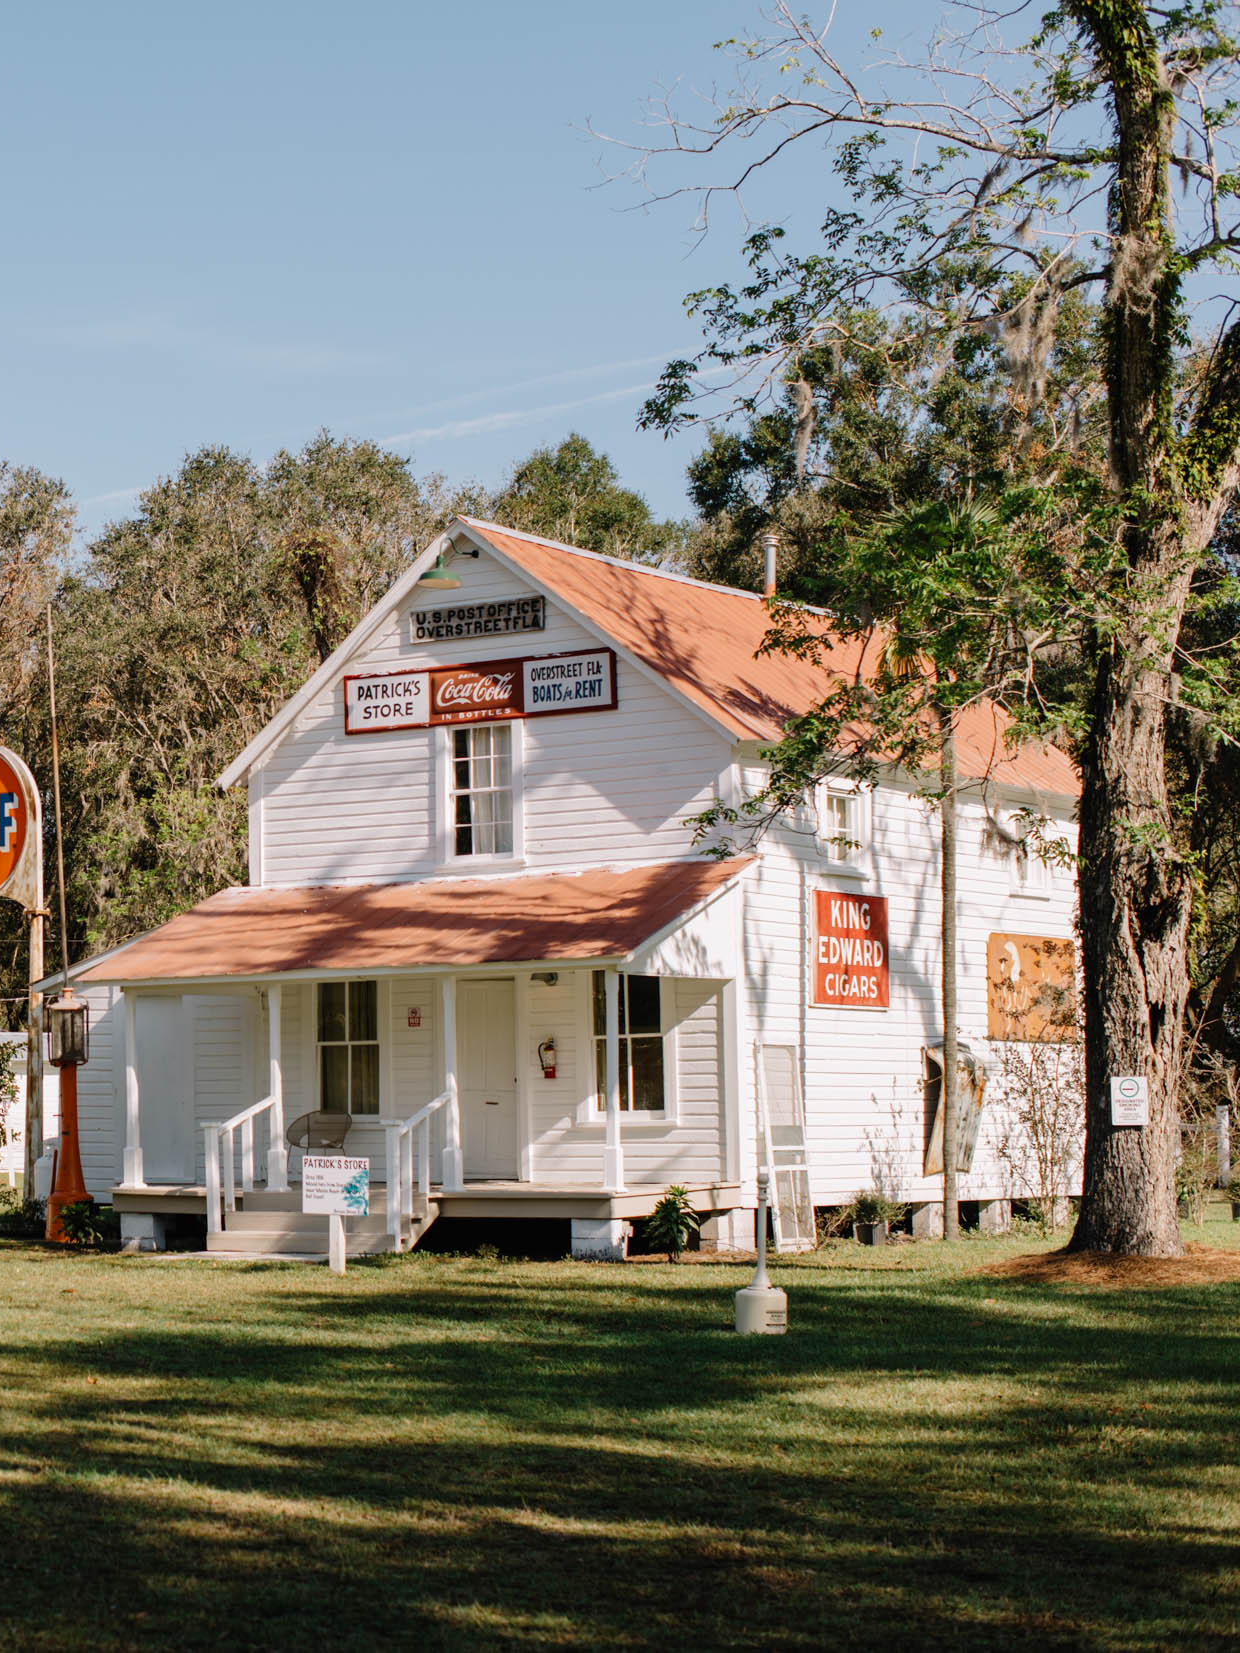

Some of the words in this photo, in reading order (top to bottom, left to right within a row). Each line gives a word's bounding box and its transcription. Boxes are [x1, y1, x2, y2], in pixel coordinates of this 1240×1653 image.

[448, 606, 486, 623] POST
[487, 600, 540, 617] OFFICE
[416, 618, 513, 639] OVERSTREET
[531, 663, 583, 682] OVERSTREET
[357, 680, 421, 701] PATRICK'S
[437, 672, 516, 707] Coca-Cola
[532, 683, 563, 703] BOATS
[575, 679, 603, 699] RENT
[363, 702, 413, 720] STORE
[441, 713, 452, 721] IN
[458, 707, 511, 719] BOTTLES
[831, 899, 871, 931] KING
[818, 935, 884, 968] EDWARD
[825, 973, 878, 999] CIGARS
[304, 1158, 342, 1169] PATRICK'S
[344, 1159, 368, 1170] STORE
